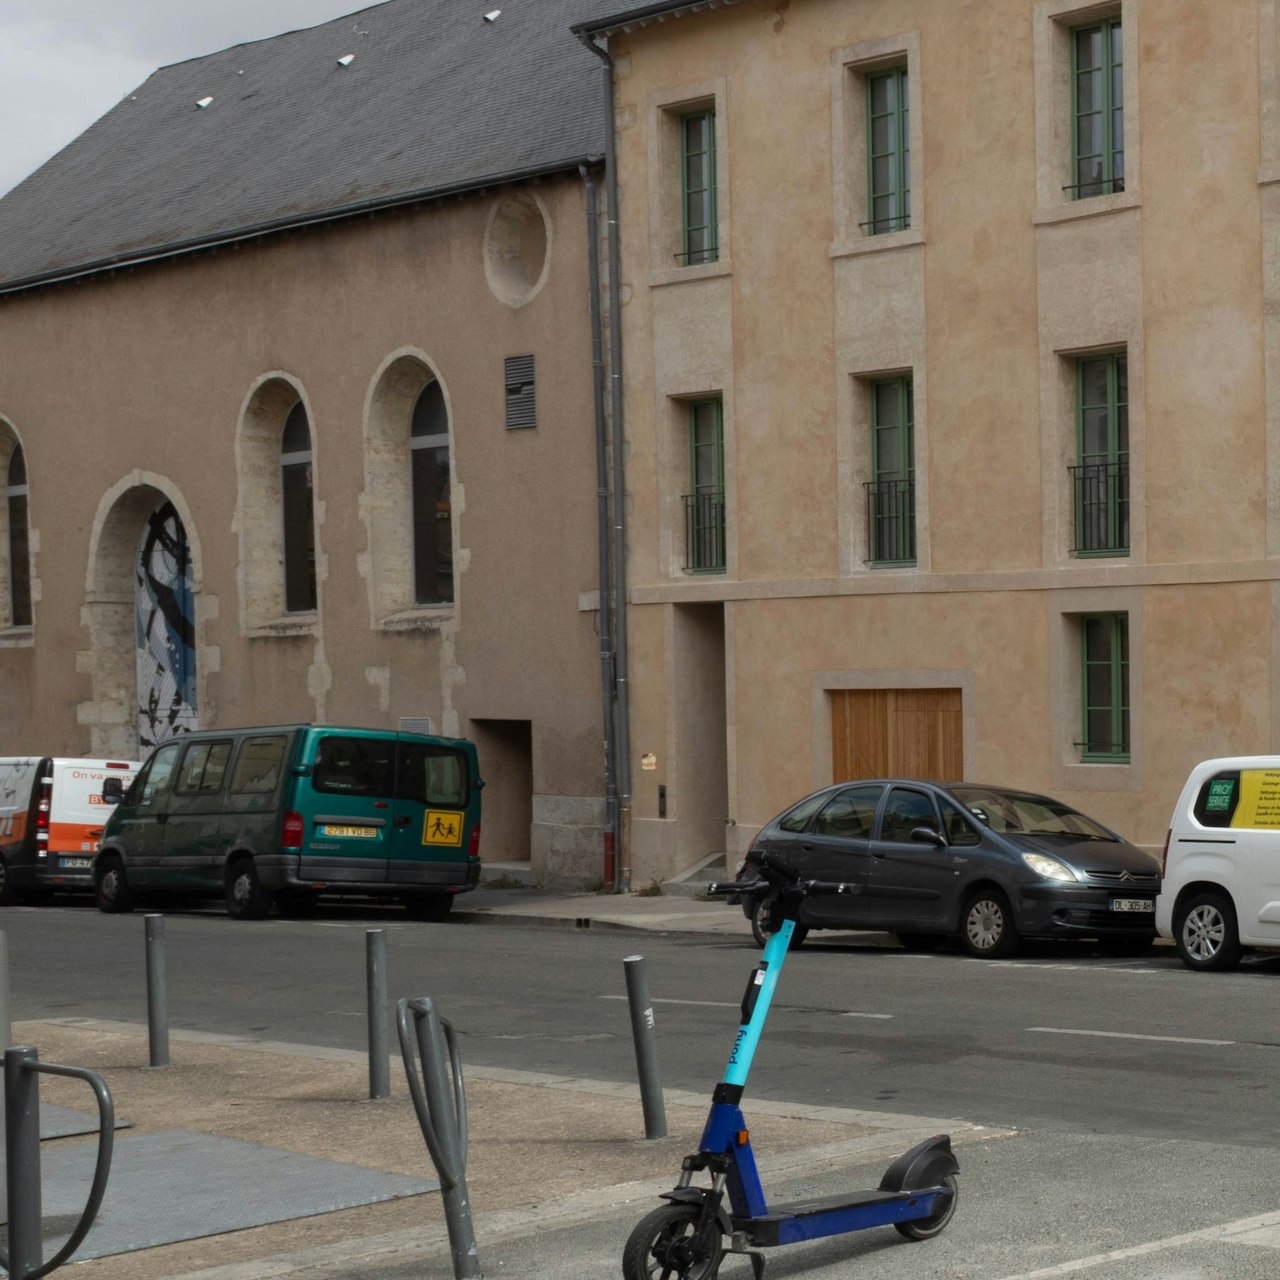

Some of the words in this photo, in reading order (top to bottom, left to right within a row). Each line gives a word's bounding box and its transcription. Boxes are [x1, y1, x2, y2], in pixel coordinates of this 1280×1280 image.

[72, 771, 87, 779] On
[1207, 795, 1230, 807] SERVICE
[728, 1029, 747, 1065] pony
